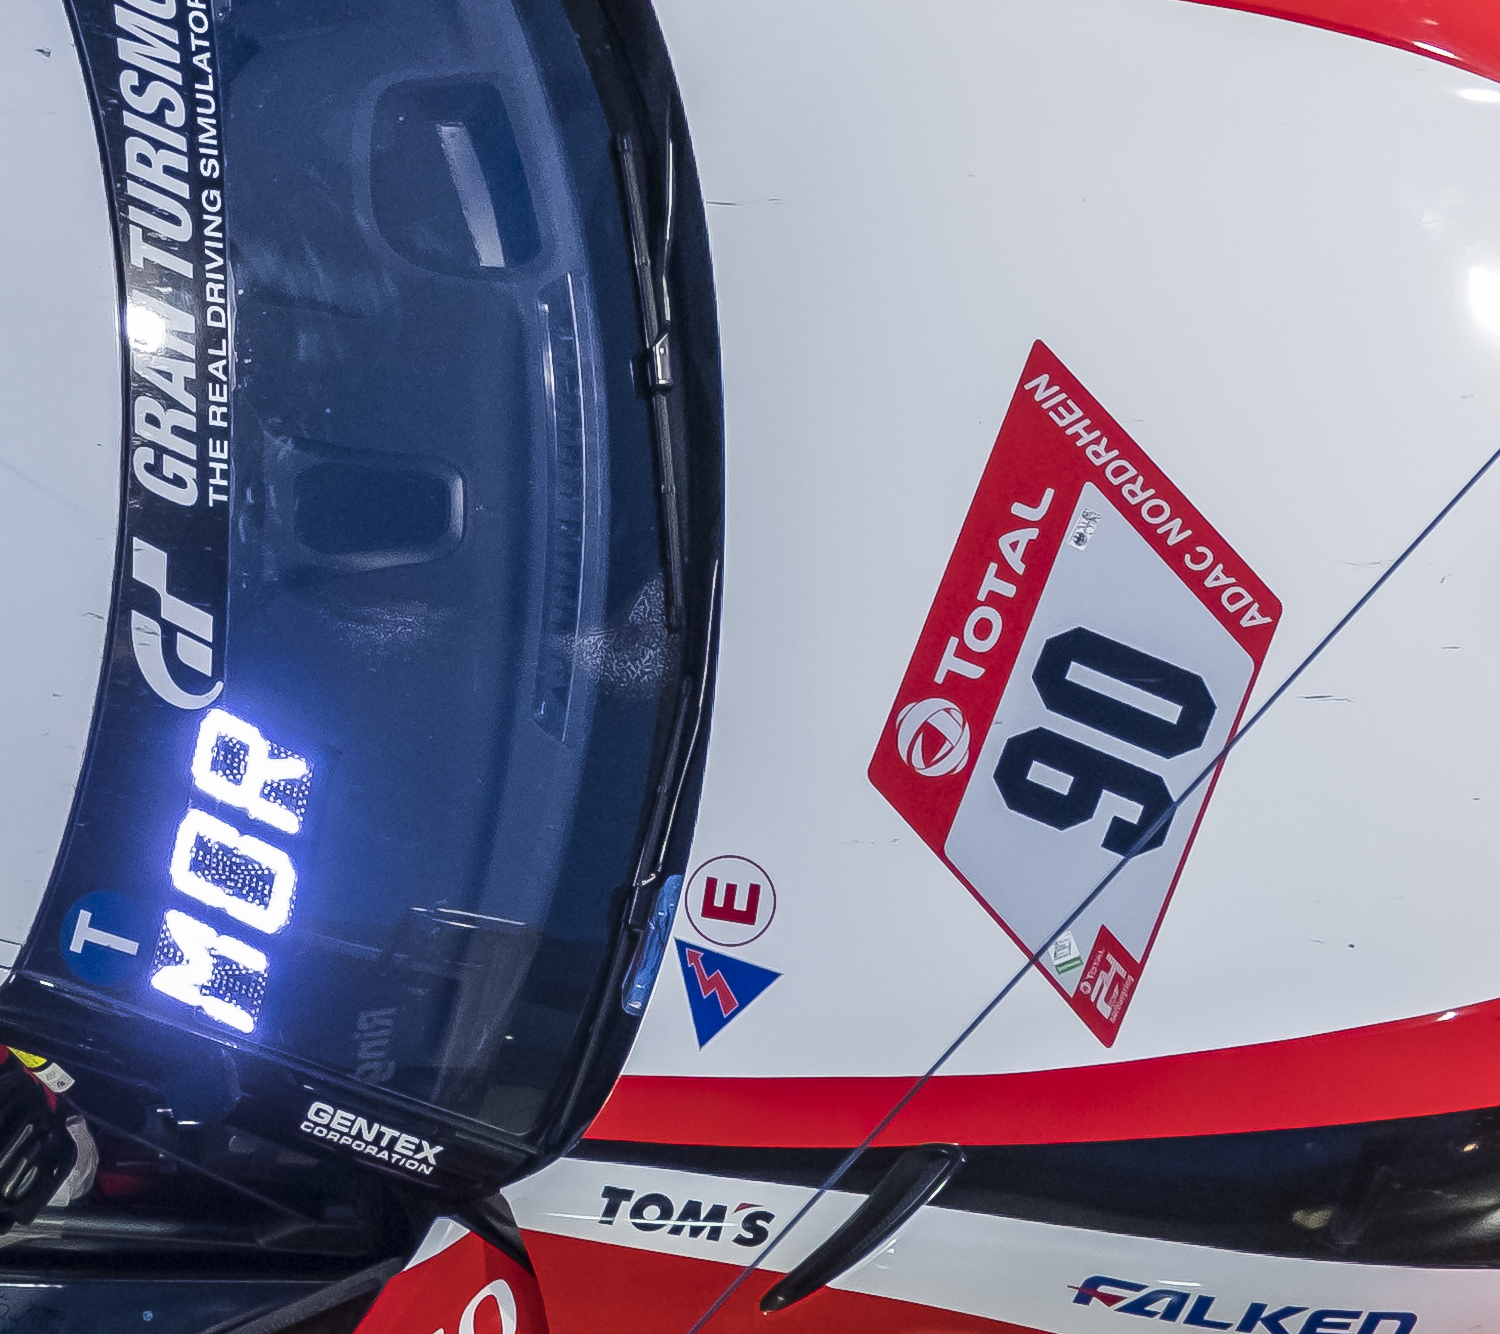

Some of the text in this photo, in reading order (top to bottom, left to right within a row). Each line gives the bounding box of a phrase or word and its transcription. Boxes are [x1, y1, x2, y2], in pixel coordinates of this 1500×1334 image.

[200, 189, 228, 328] DRIVING
[129, 285, 199, 507] GRAN
[206, 340, 229, 433] REAL
[208, 439, 229, 507] THE
[1023, 372, 1273, 630] ADAC NORDRHEIN
[934, 487, 1056, 686] TOTAL
[992, 626, 1218, 859] 90
[151, 706, 314, 1034] MOR
[701, 875, 761, 927] E
[69, 909, 140, 956] T
[299, 1119, 435, 1176] CORPORATION
[306, 1100, 445, 1167] GENTEX
[597, 1184, 777, 1248] TOM'S
